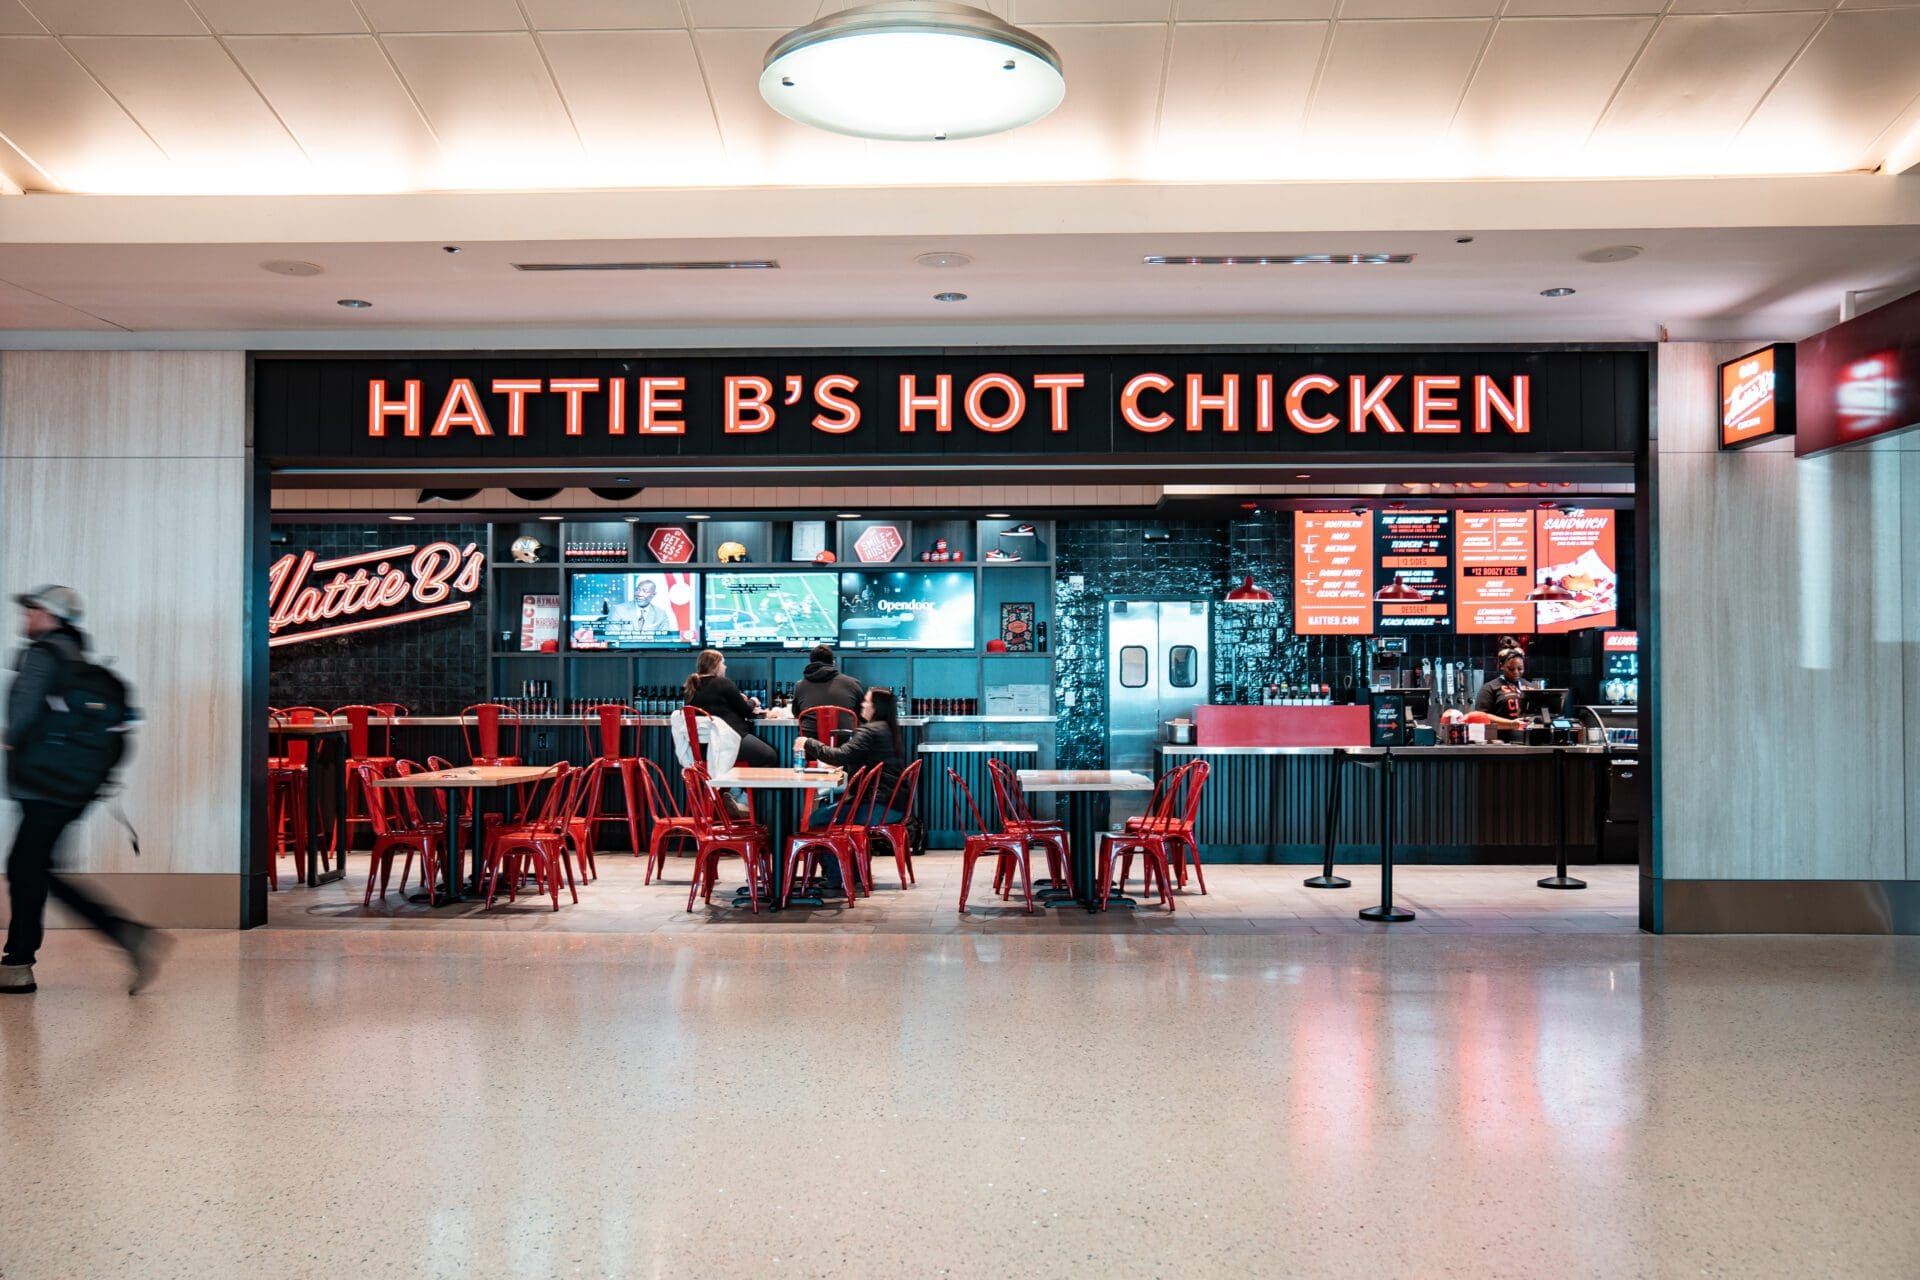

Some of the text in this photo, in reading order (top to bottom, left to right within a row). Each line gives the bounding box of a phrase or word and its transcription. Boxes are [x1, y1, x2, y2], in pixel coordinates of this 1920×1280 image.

[369, 372, 1530, 436] HATTIE B'S HOT CHICKEN
[1543, 517, 1608, 530] SANDWICH
[663, 533, 681, 547] GET
[1483, 568, 1502, 576] BOOZY
[1504, 568, 1518, 576] ICEE
[878, 599, 936, 613] Opendoor
[1401, 605, 1428, 614] DESSERT
[520, 596, 536, 650] WILCO
